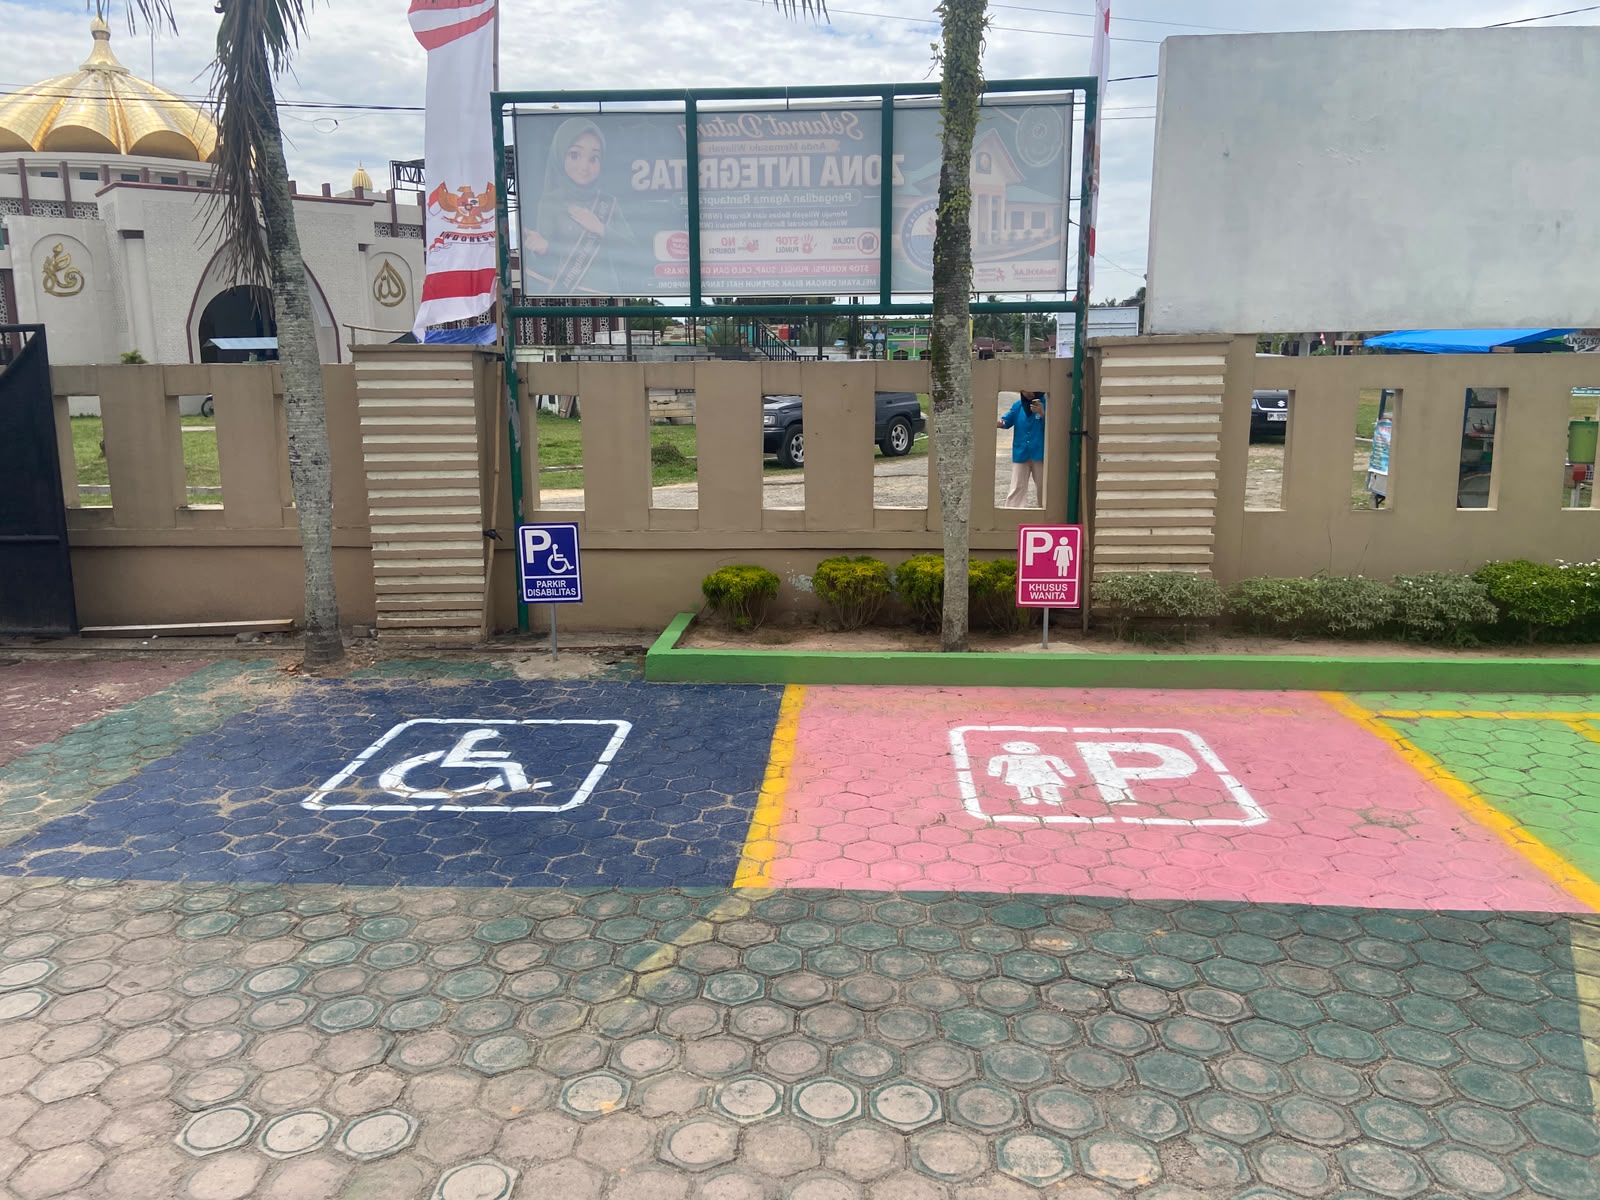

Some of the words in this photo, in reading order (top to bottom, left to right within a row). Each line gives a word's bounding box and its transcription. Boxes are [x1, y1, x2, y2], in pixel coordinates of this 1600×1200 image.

[440, 231, 496, 243] INDONESI
[525, 529, 552, 564] P
[1025, 531, 1054, 566] P
[536, 580, 566, 588] PARKIR
[1028, 583, 1068, 592] KHUSUS
[527, 587, 577, 597] DISABILITAS
[1030, 591, 1066, 600] WANITA
[1075, 741, 1197, 806] P
